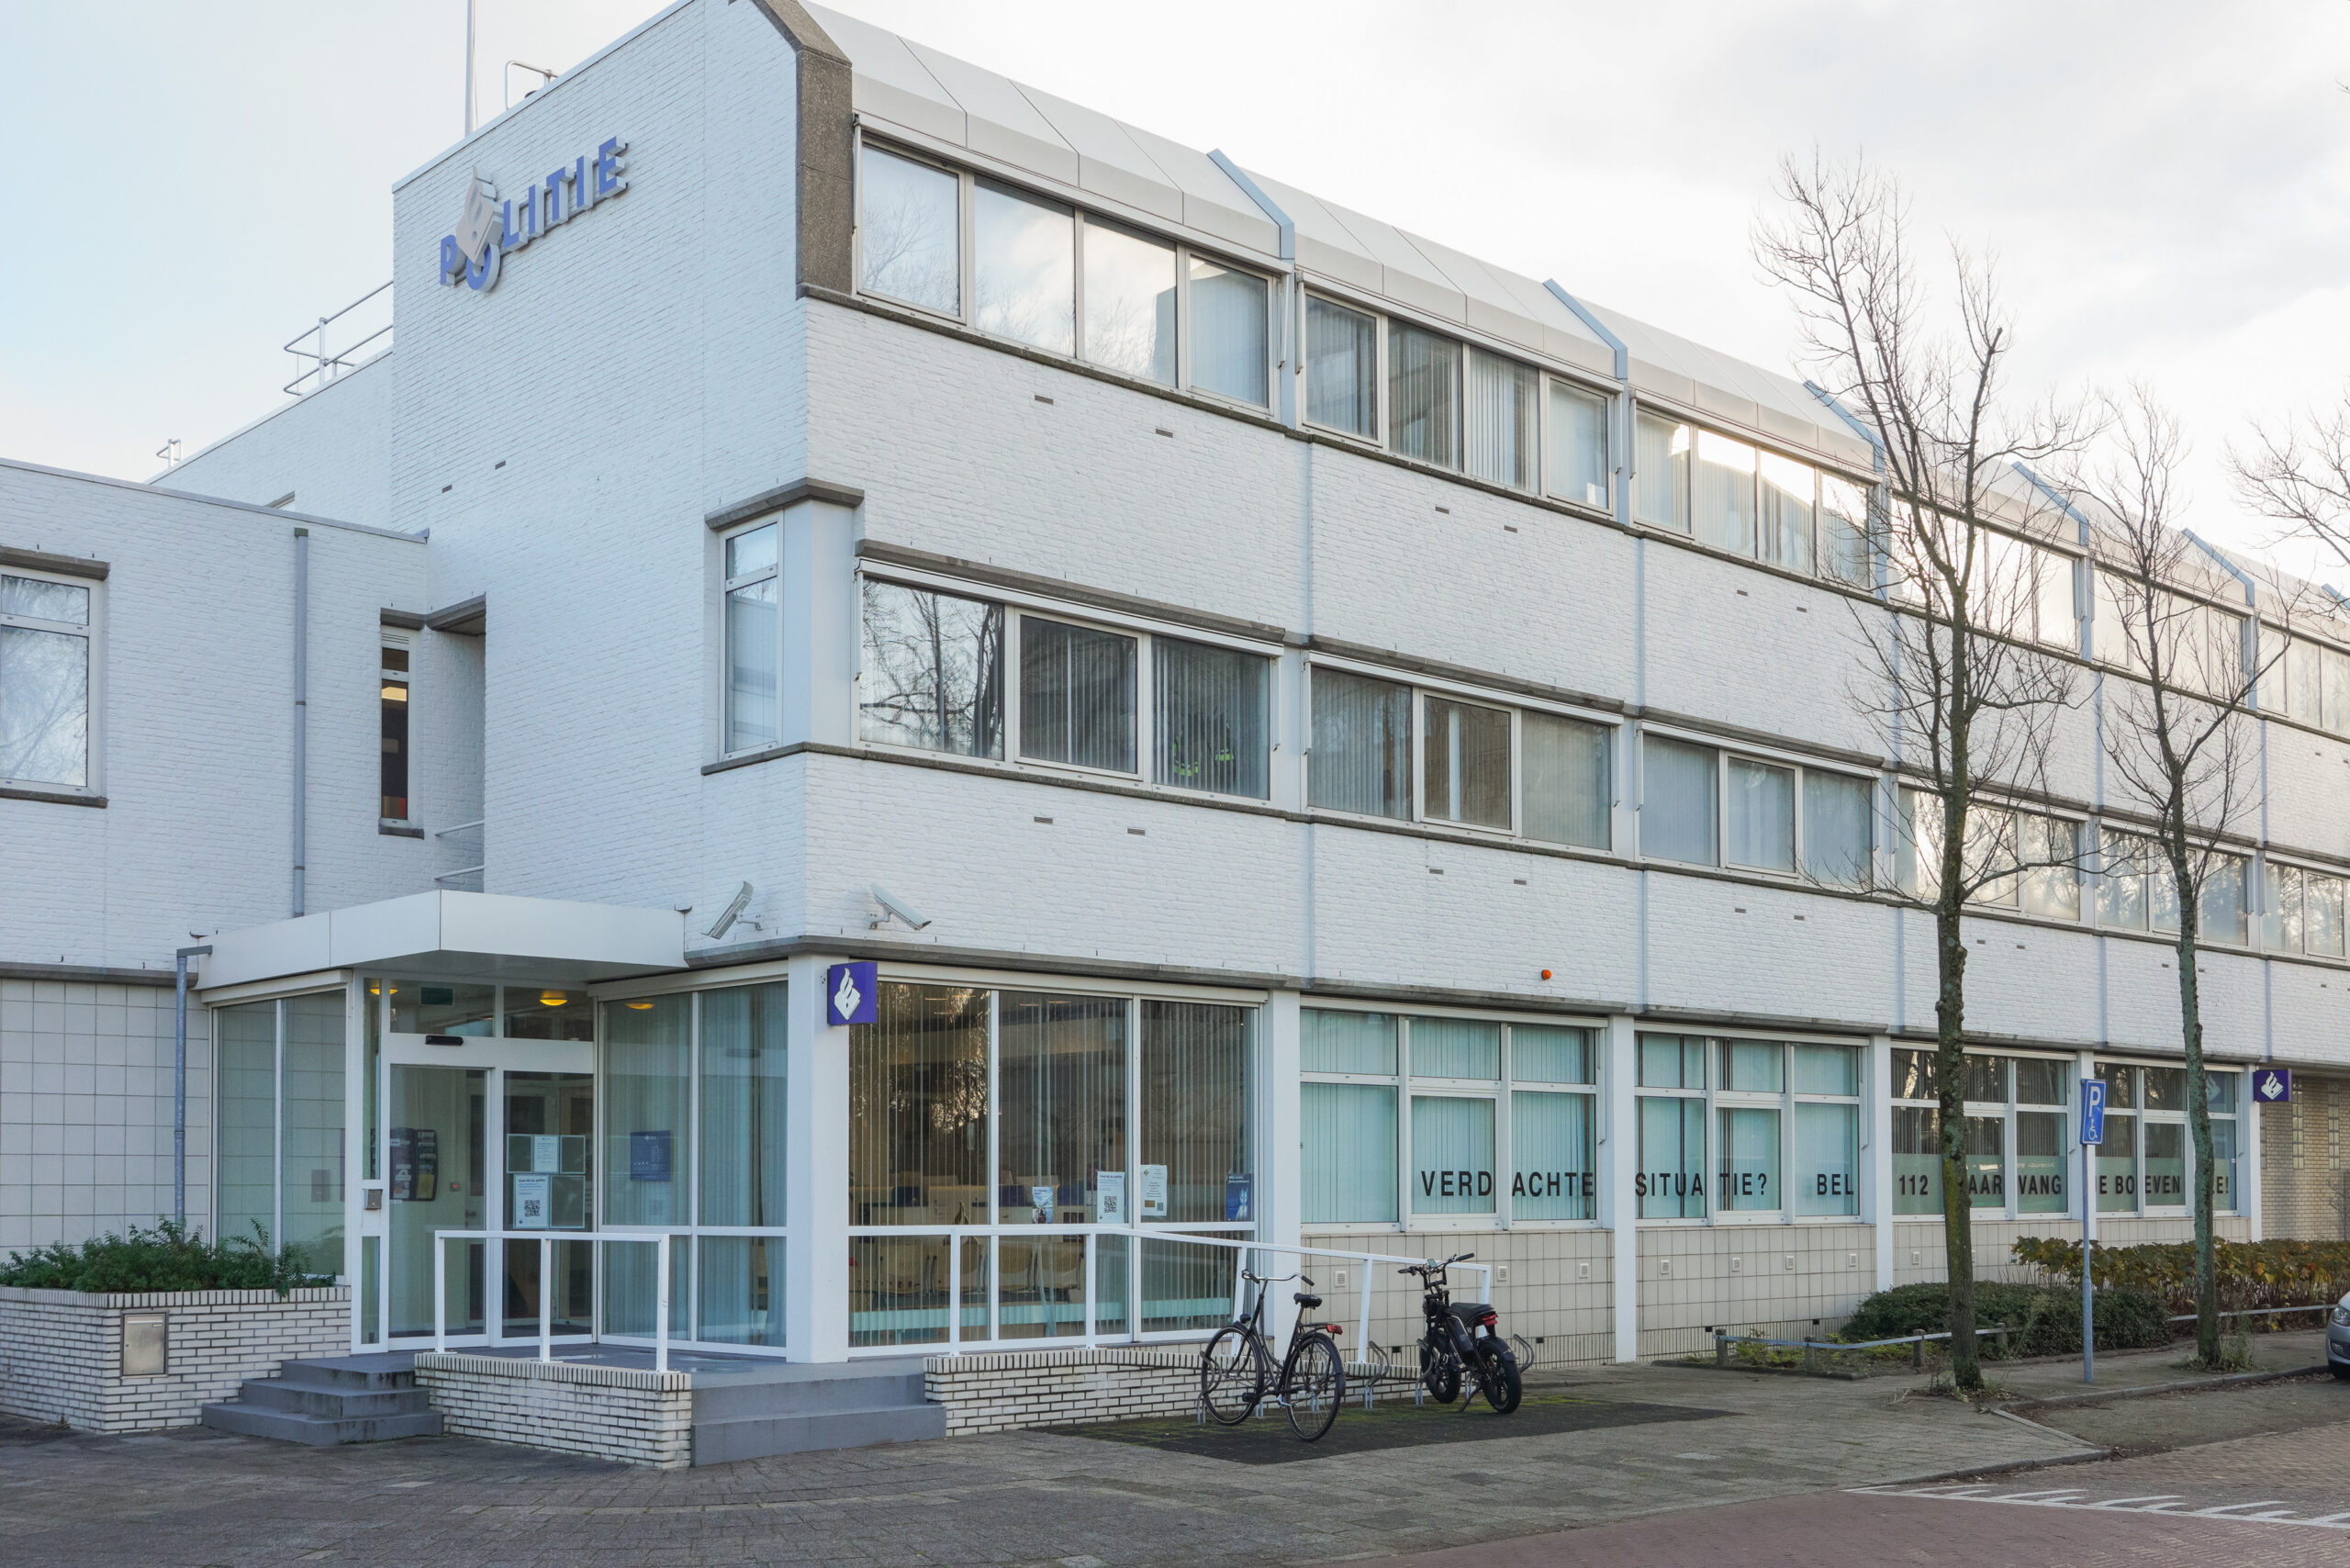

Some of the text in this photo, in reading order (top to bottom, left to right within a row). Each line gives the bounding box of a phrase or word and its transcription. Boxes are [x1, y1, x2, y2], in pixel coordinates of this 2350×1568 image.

[440, 136, 629, 293] POLITIE
[2088, 1086, 2101, 1117] P
[1817, 1173, 1854, 1196] BEL
[1898, 1174, 1929, 1196] 112
[1968, 1174, 2003, 1195] AAR
[2018, 1174, 2062, 1195] VANG
